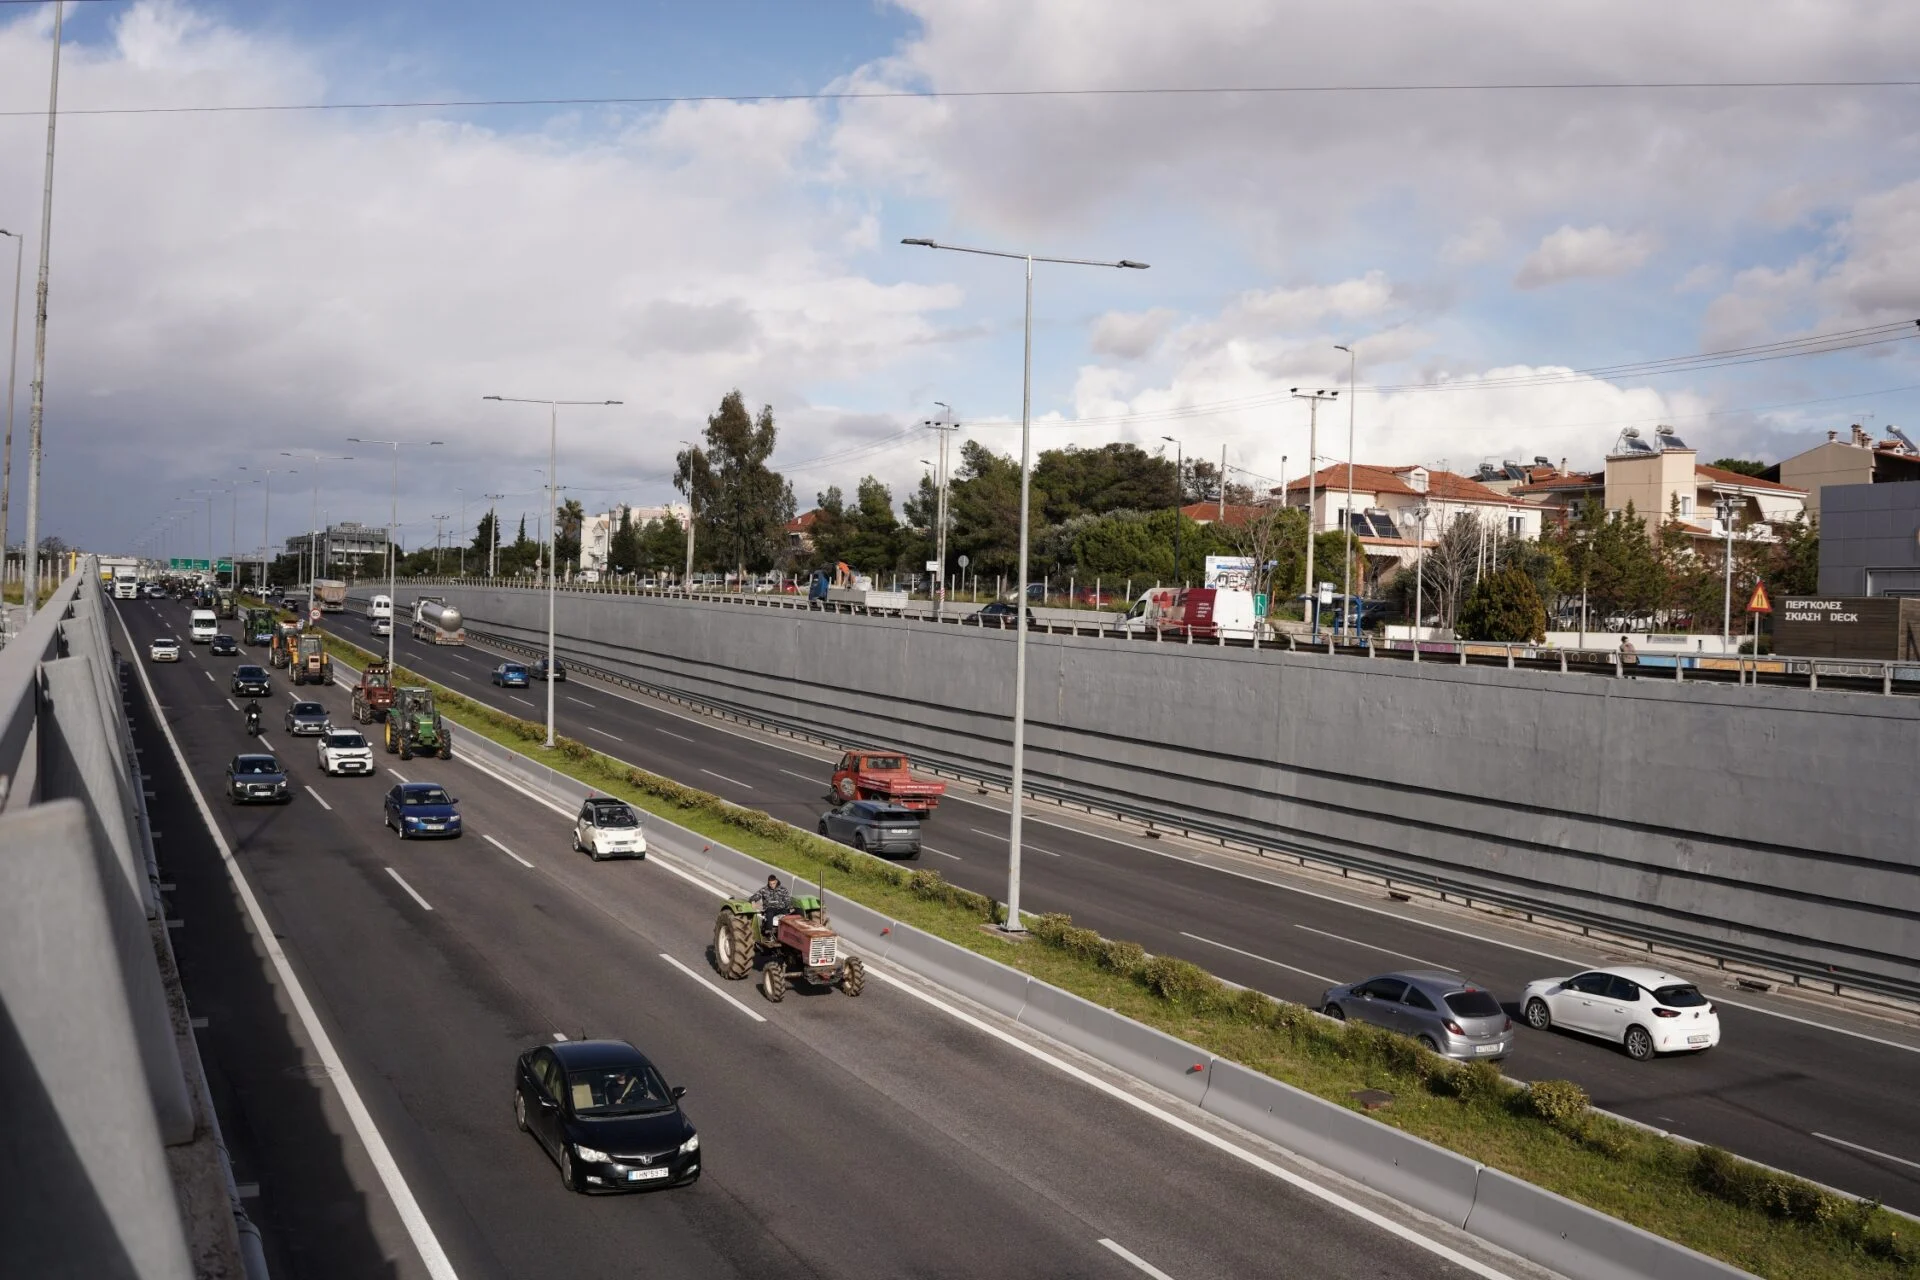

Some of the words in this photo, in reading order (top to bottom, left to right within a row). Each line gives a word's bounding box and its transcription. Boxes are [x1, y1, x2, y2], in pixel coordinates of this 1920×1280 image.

[357, 527, 384, 535] HOTEL
[1785, 600, 1843, 610] ΠΕΡΓΚΟΛΕΣ
[1785, 612, 1821, 621] ΣΚΙΑΣΗ
[1830, 613, 1858, 622] DECK
